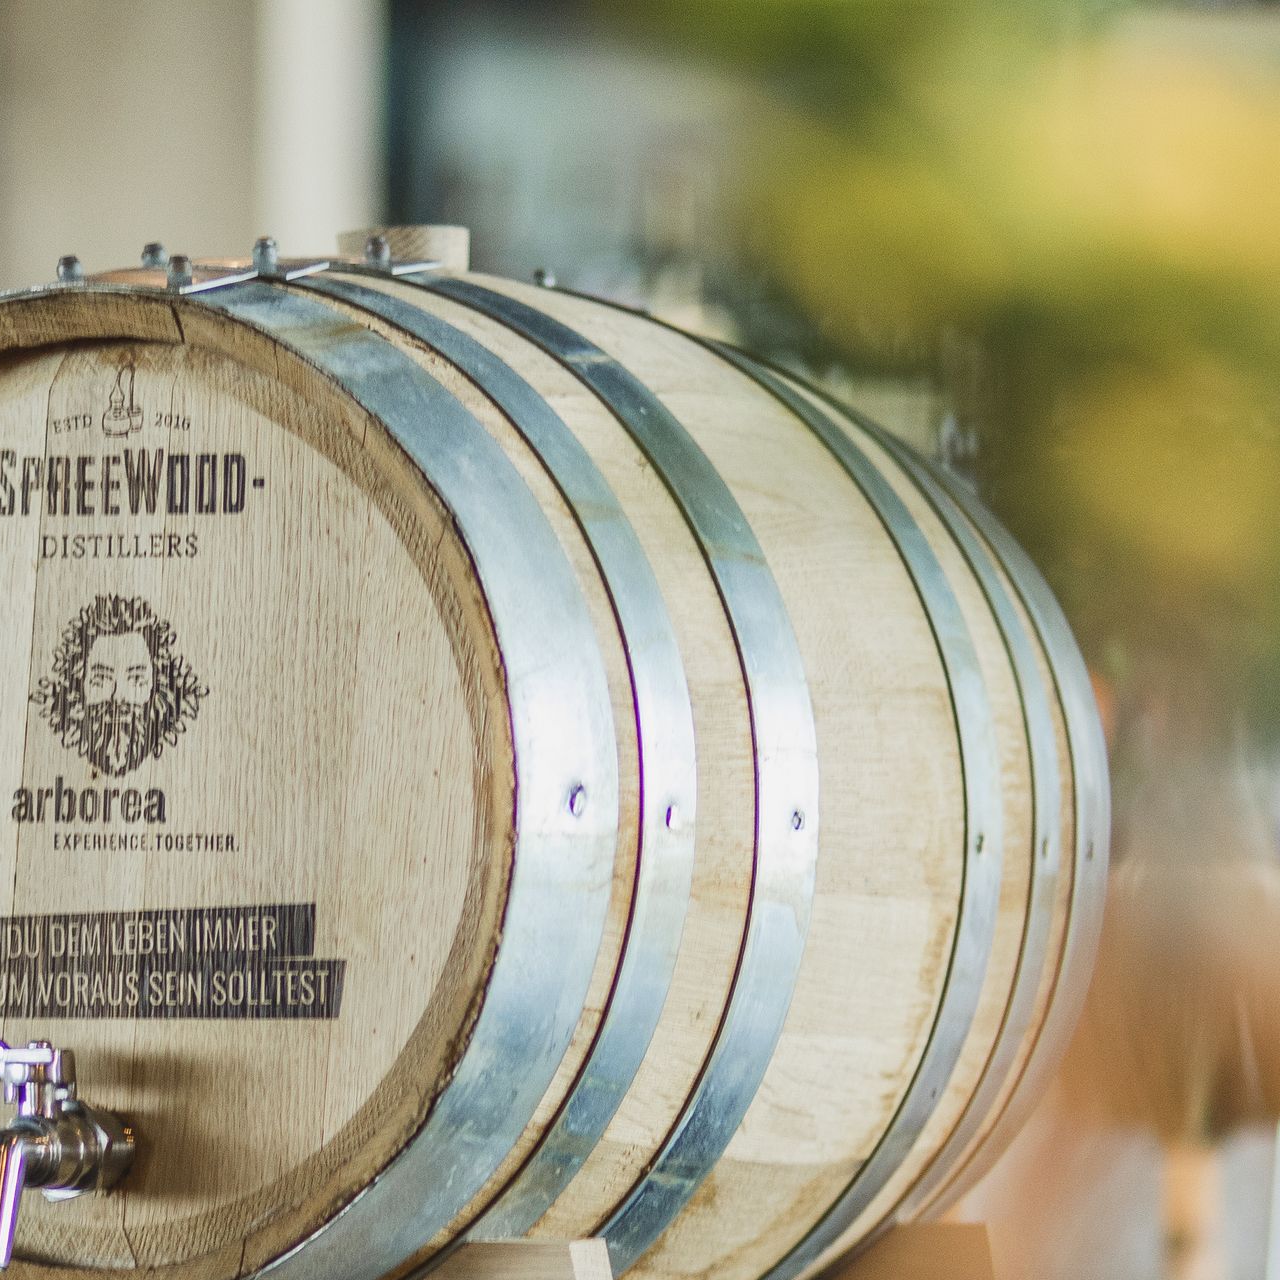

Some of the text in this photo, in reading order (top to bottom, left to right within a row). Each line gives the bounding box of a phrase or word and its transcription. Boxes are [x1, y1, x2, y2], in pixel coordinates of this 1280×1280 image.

[154, 412, 191, 432] 2016
[41, 533, 199, 559] DISTILLERS
[11, 775, 167, 824] arborea
[6, 923, 41, 960] DU
[50, 921, 101, 958] DEM
[111, 918, 186, 956] LEBEN
[195, 915, 277, 953] IMMER
[36, 970, 139, 1007] VORAUS
[149, 970, 202, 1006] SEIN
[211, 969, 329, 1007] SOLLTEST
